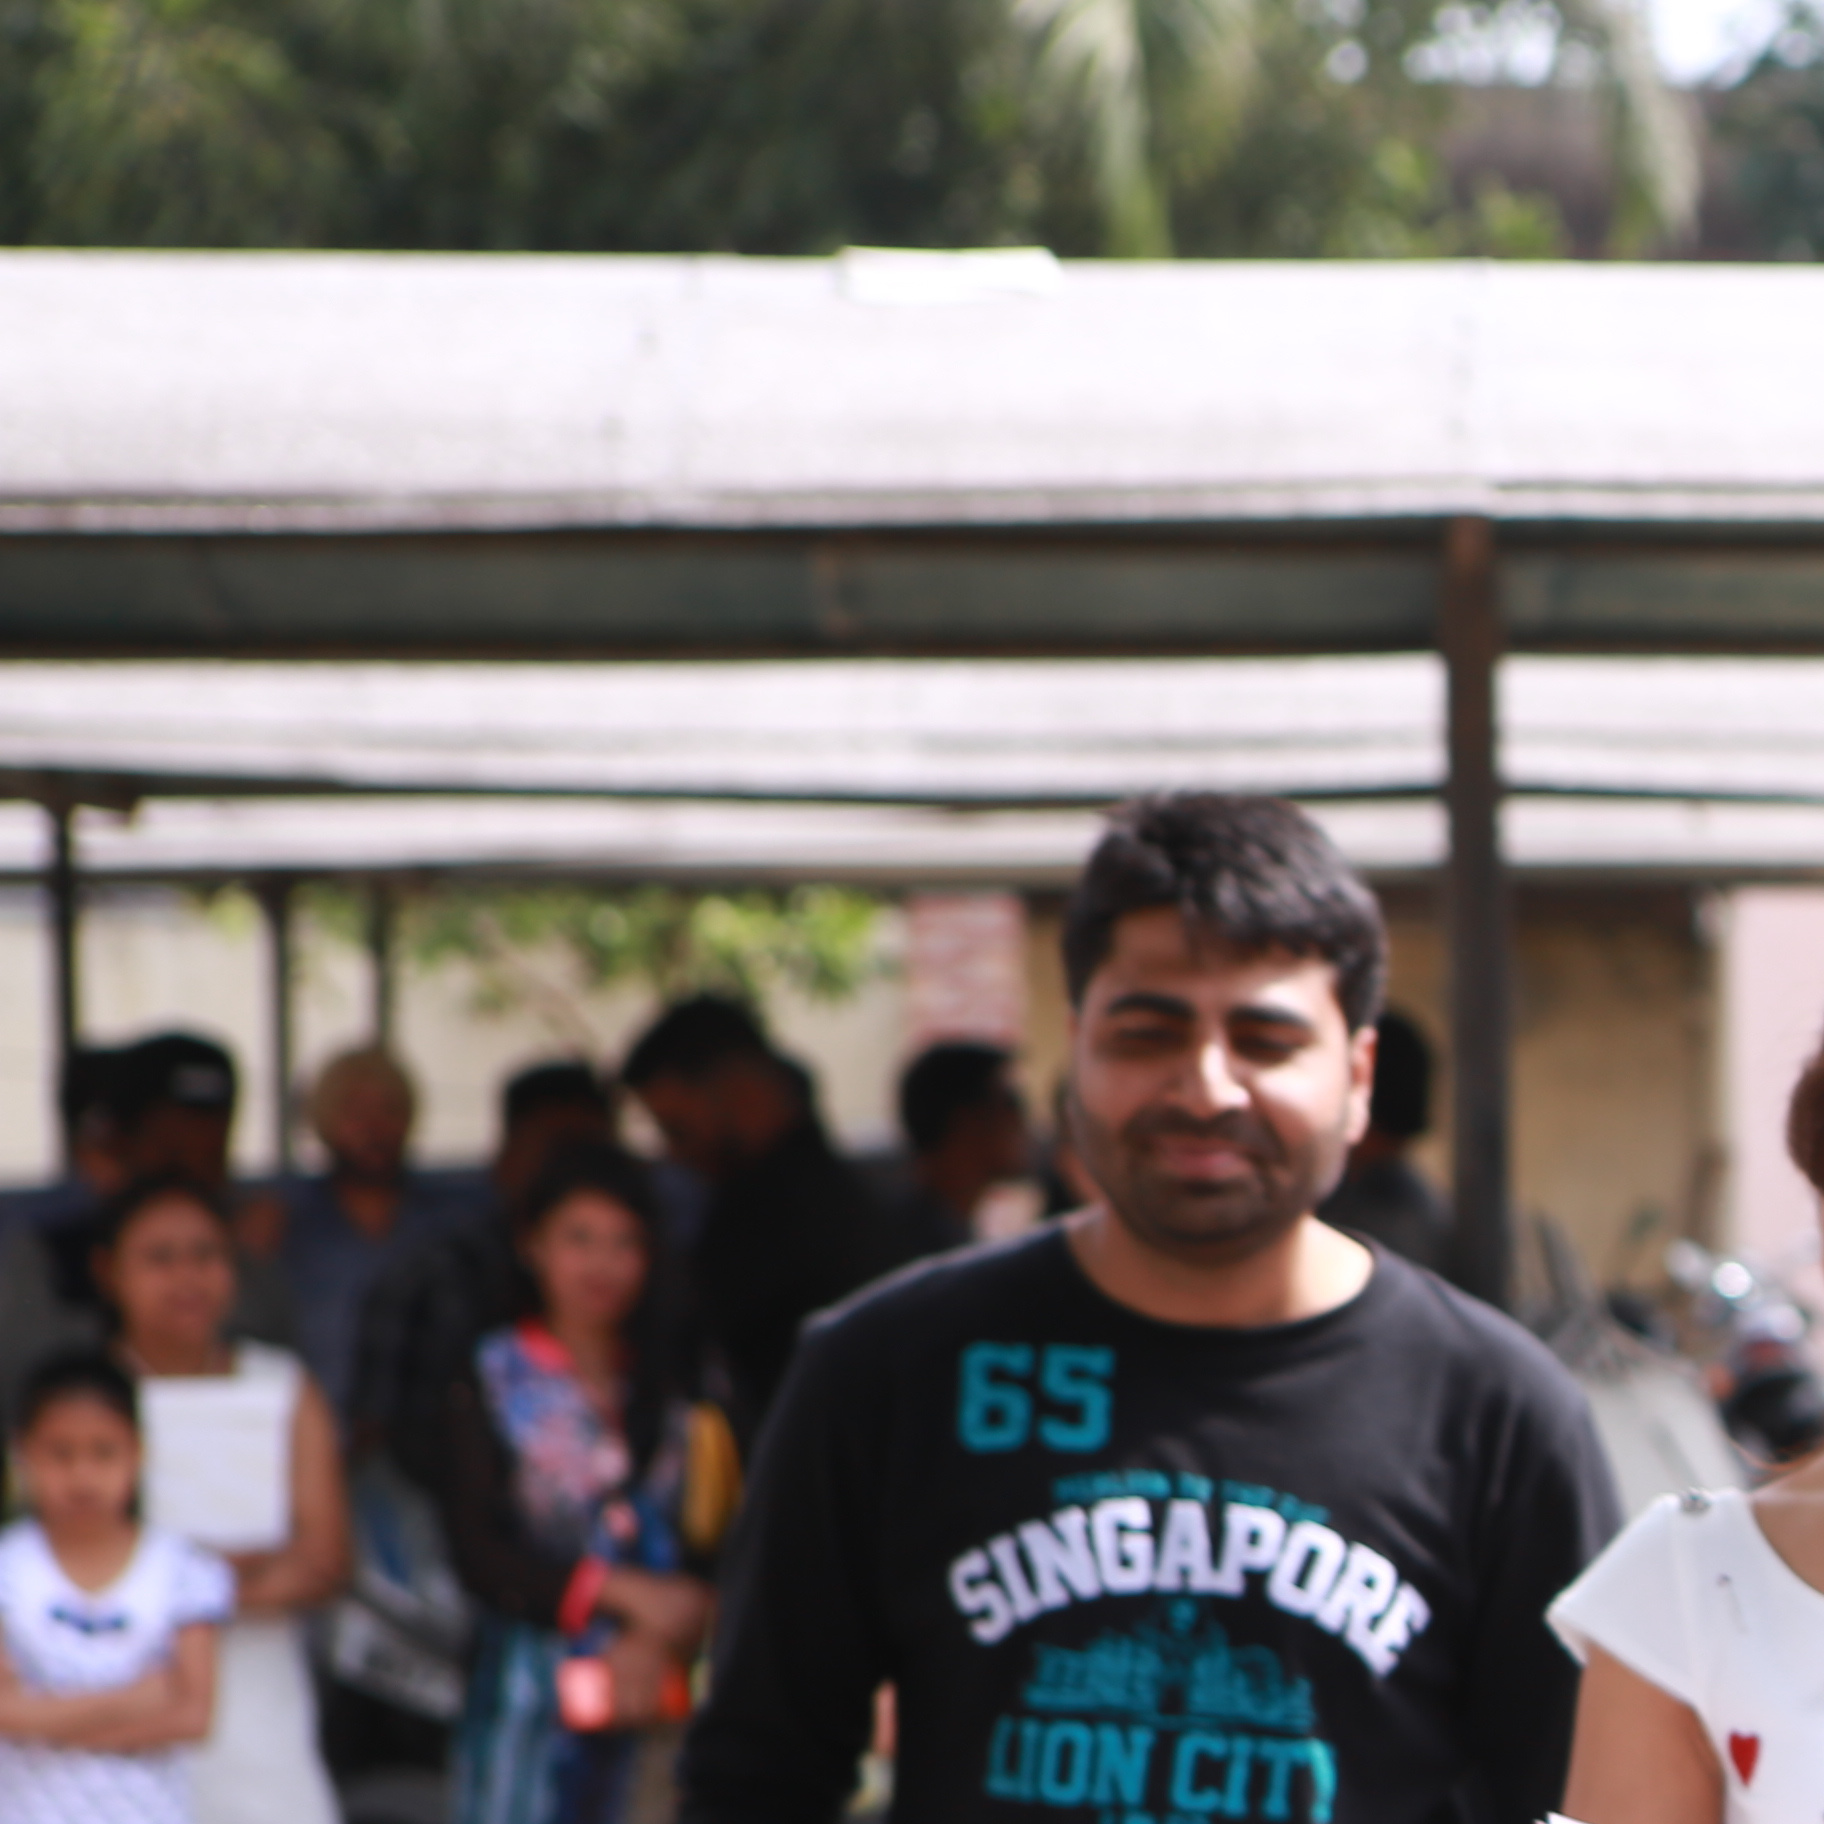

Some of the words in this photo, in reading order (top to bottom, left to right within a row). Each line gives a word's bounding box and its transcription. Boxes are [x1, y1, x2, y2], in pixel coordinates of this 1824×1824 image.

[961, 1343, 1113, 1452] 65
[949, 1497, 1430, 1676] SINGAPORE
[988, 1716, 1153, 1808] LION
[1172, 1737, 1336, 1824] CITY
